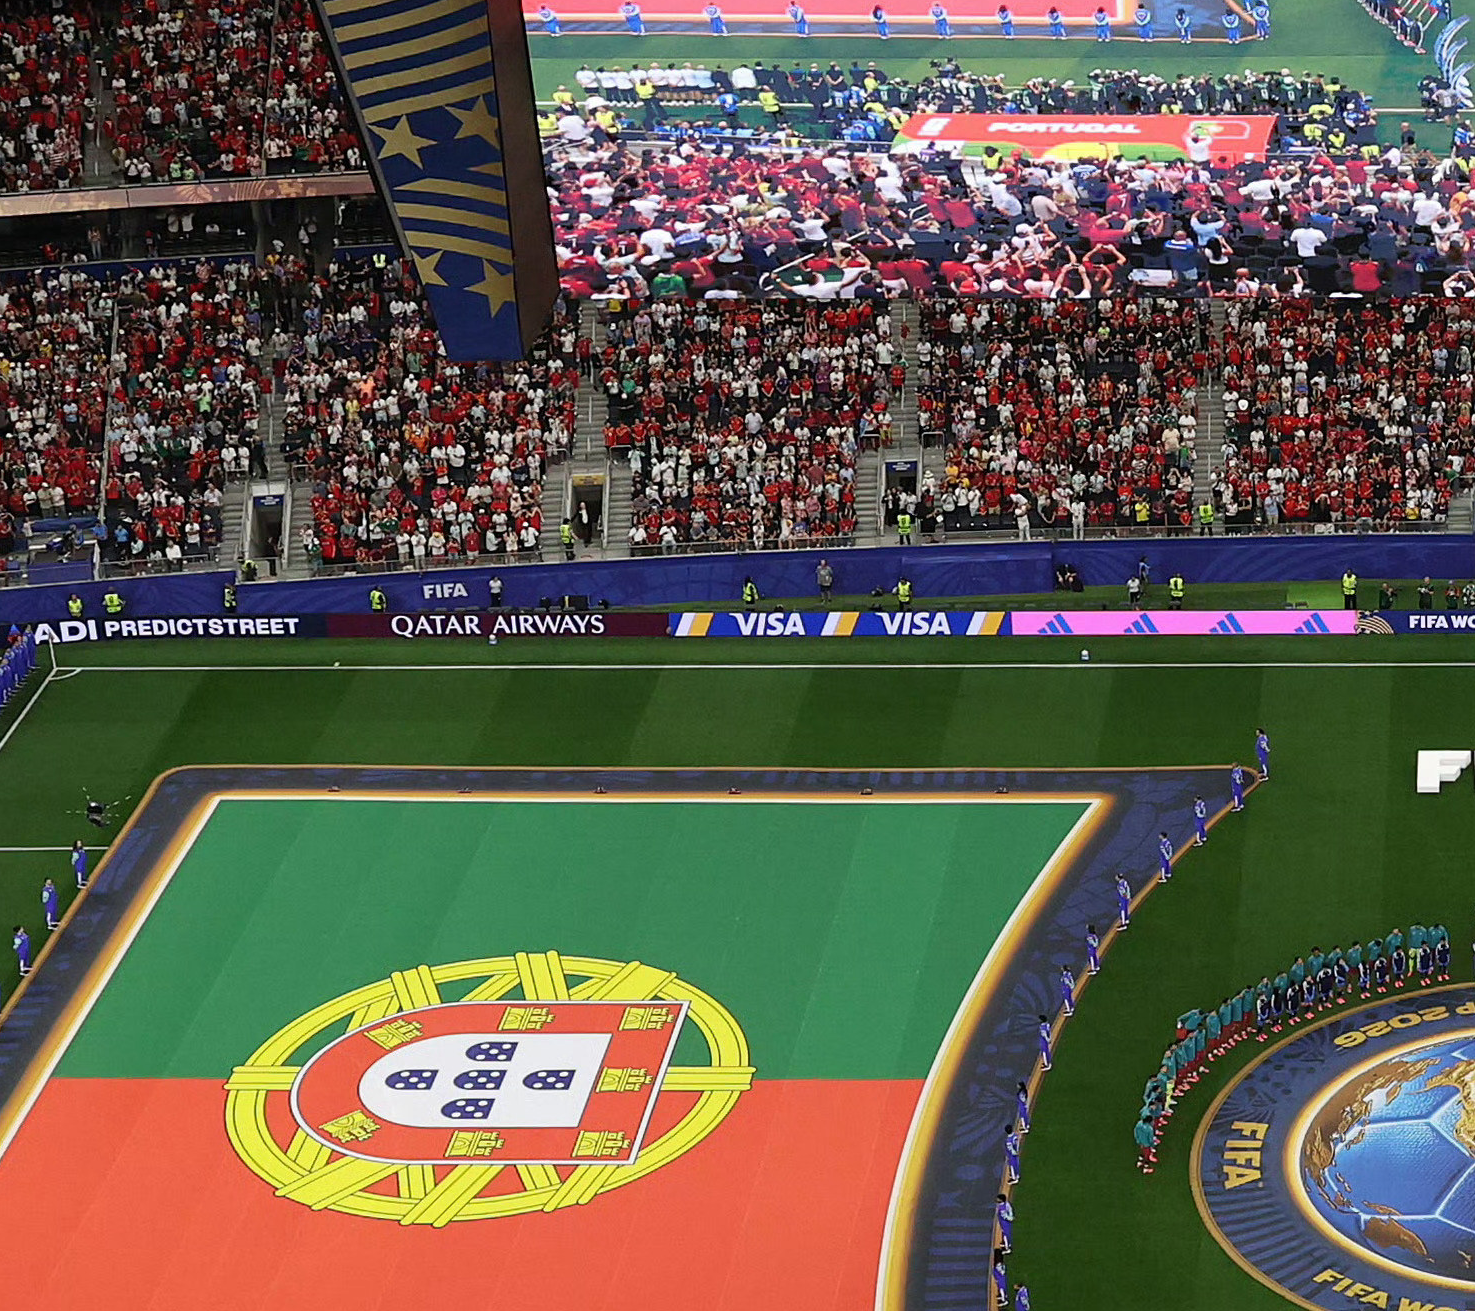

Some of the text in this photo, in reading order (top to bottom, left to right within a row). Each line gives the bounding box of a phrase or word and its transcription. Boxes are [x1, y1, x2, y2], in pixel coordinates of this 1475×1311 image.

[987, 122, 1142, 135] PORTUGAL
[423, 583, 469, 600] FIFA
[35, 618, 300, 645] ADI PREDICTSTREET
[391, 614, 606, 638] QATAR AIRWAYS
[729, 612, 806, 637] VISA
[874, 612, 952, 636] VISA
[1409, 614, 1448, 629] FIFA
[1333, 1007, 1449, 1049] 2026
[1223, 1120, 1270, 1190] FIFA
[1312, 1267, 1389, 1309] FIFA
